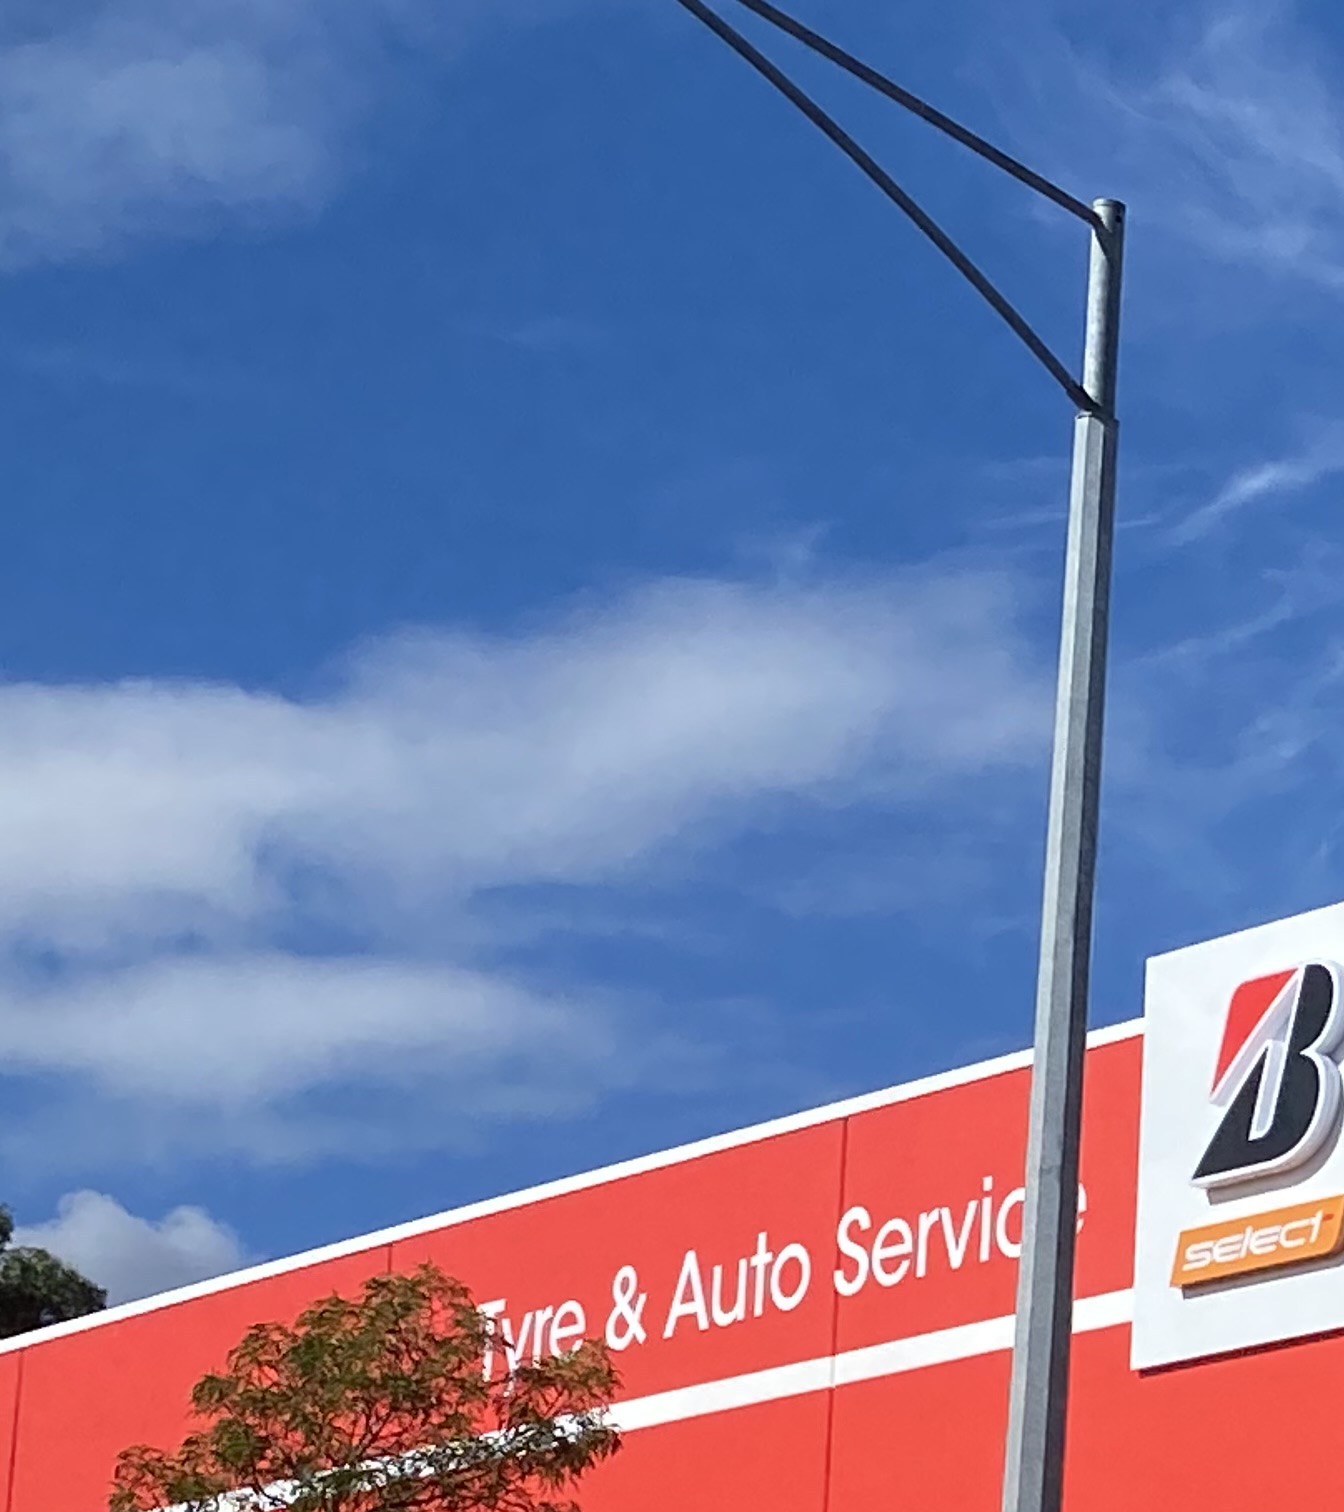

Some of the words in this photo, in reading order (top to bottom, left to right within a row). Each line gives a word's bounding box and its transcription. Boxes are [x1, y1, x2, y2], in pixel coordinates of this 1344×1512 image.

[475, 1297, 586, 1398] Tyre
[604, 1264, 647, 1351] &
[662, 1230, 812, 1339] Auto
[833, 1175, 1087, 1298] Servic
[1181, 1207, 1335, 1272] select
